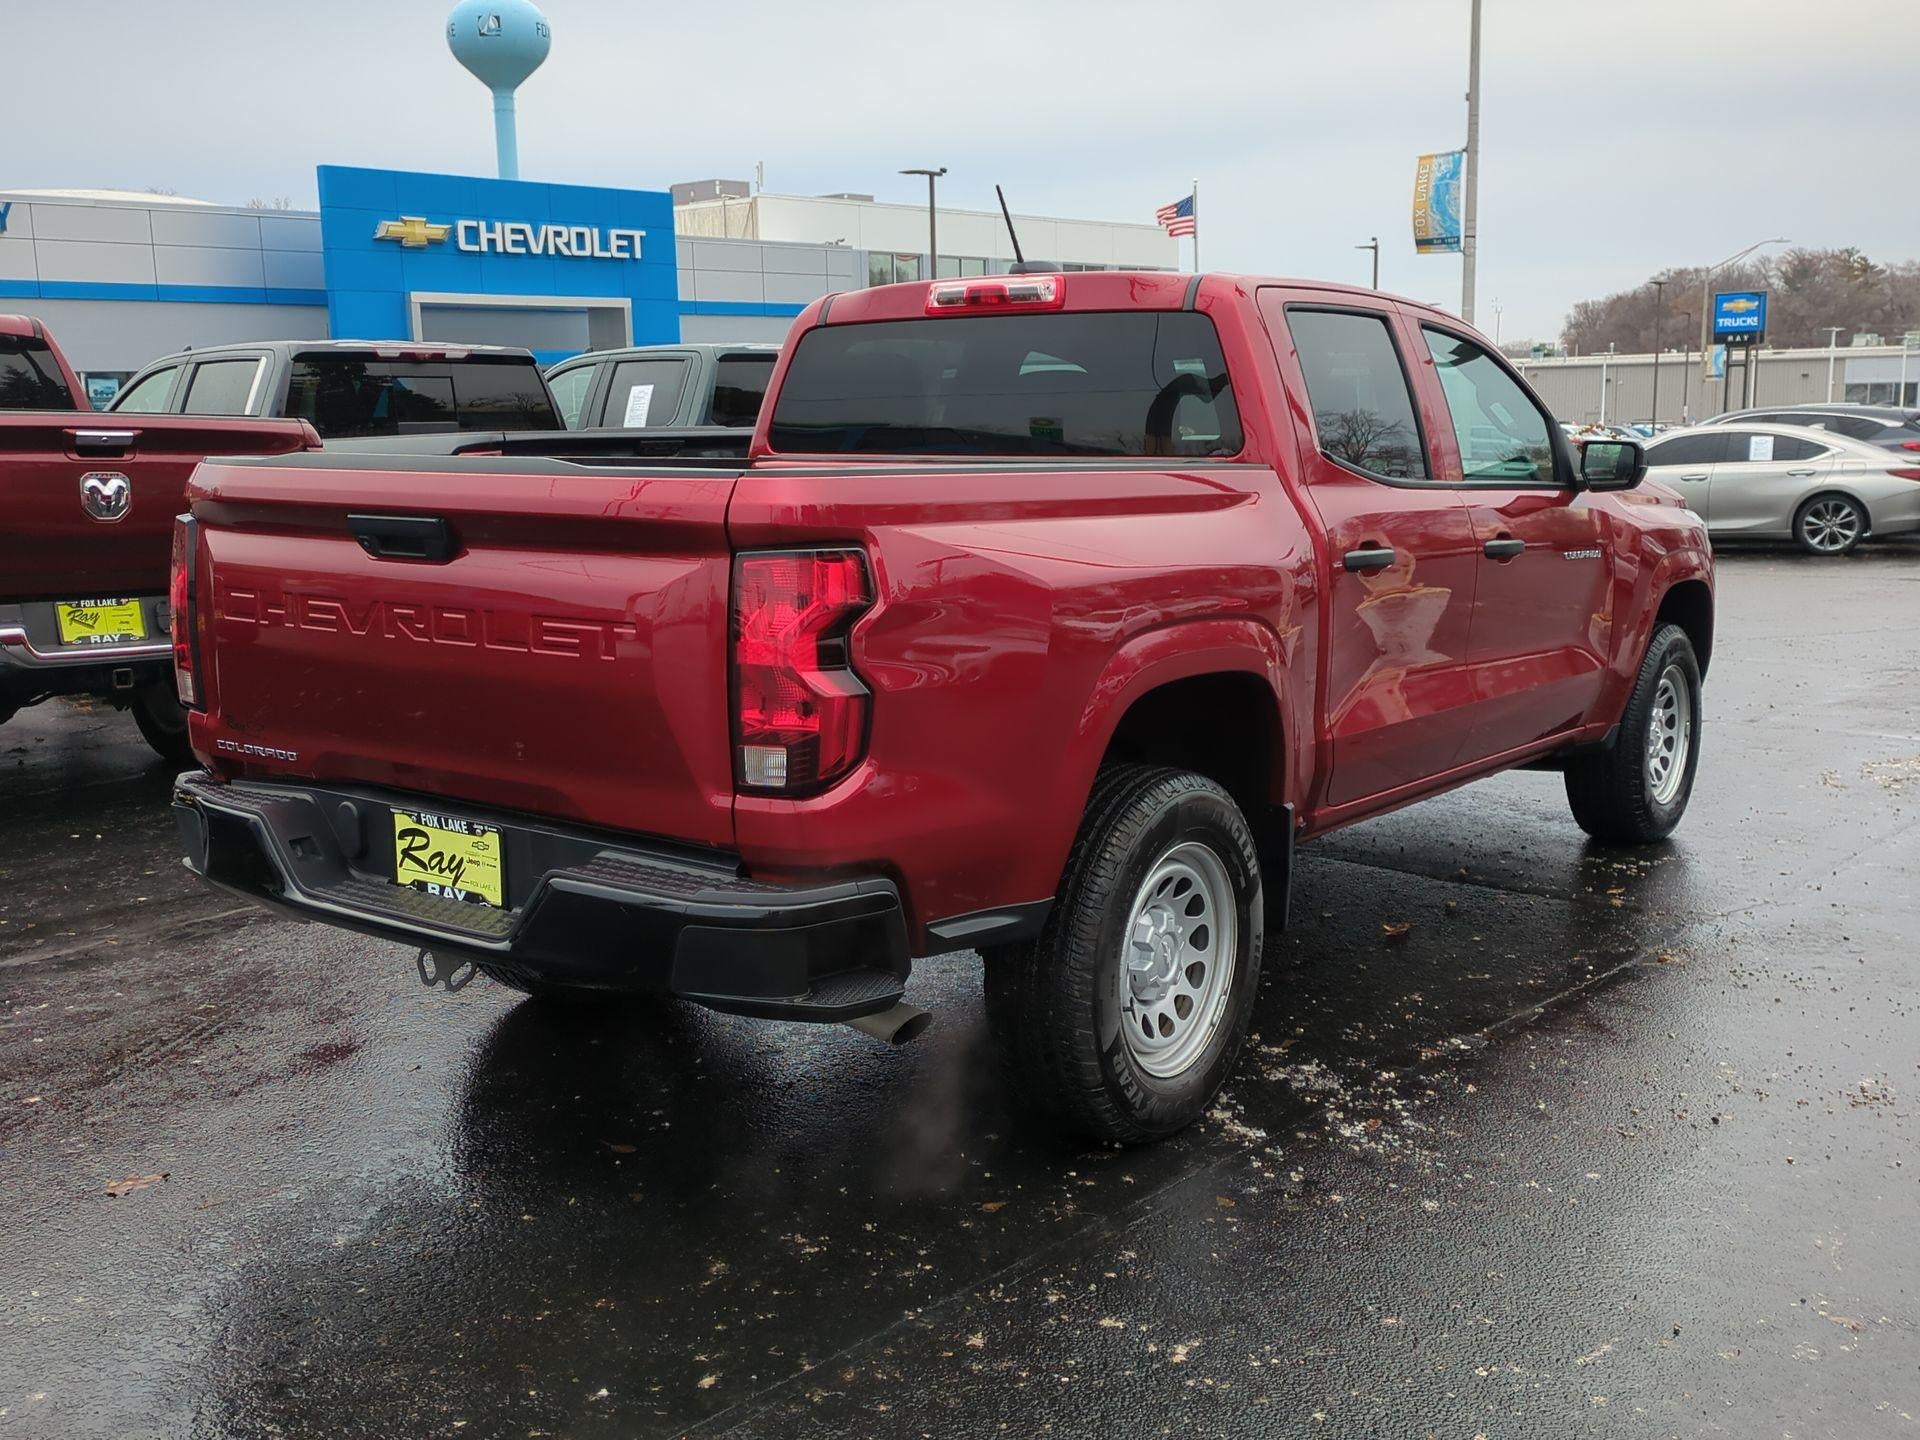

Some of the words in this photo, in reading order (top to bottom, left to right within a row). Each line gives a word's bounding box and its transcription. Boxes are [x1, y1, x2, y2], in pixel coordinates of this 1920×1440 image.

[1416, 163, 1430, 203] LAKE
[1416, 208, 1426, 236] FOX
[455, 219, 647, 260] CHEVROLET
[1717, 316, 1759, 328] TRUCKS
[80, 599, 96, 608] FOX
[97, 598, 118, 607] LAKE
[66, 608, 100, 627] Ray
[222, 585, 638, 662] CHEVROLET
[90, 633, 121, 644] RAY
[216, 738, 298, 762] COLORADO
[420, 813, 440, 829] FOX
[441, 817, 469, 834] LAKE
[397, 827, 466, 887] Ray
[466, 857, 481, 867] Jeep
[427, 882, 467, 902] RAY
